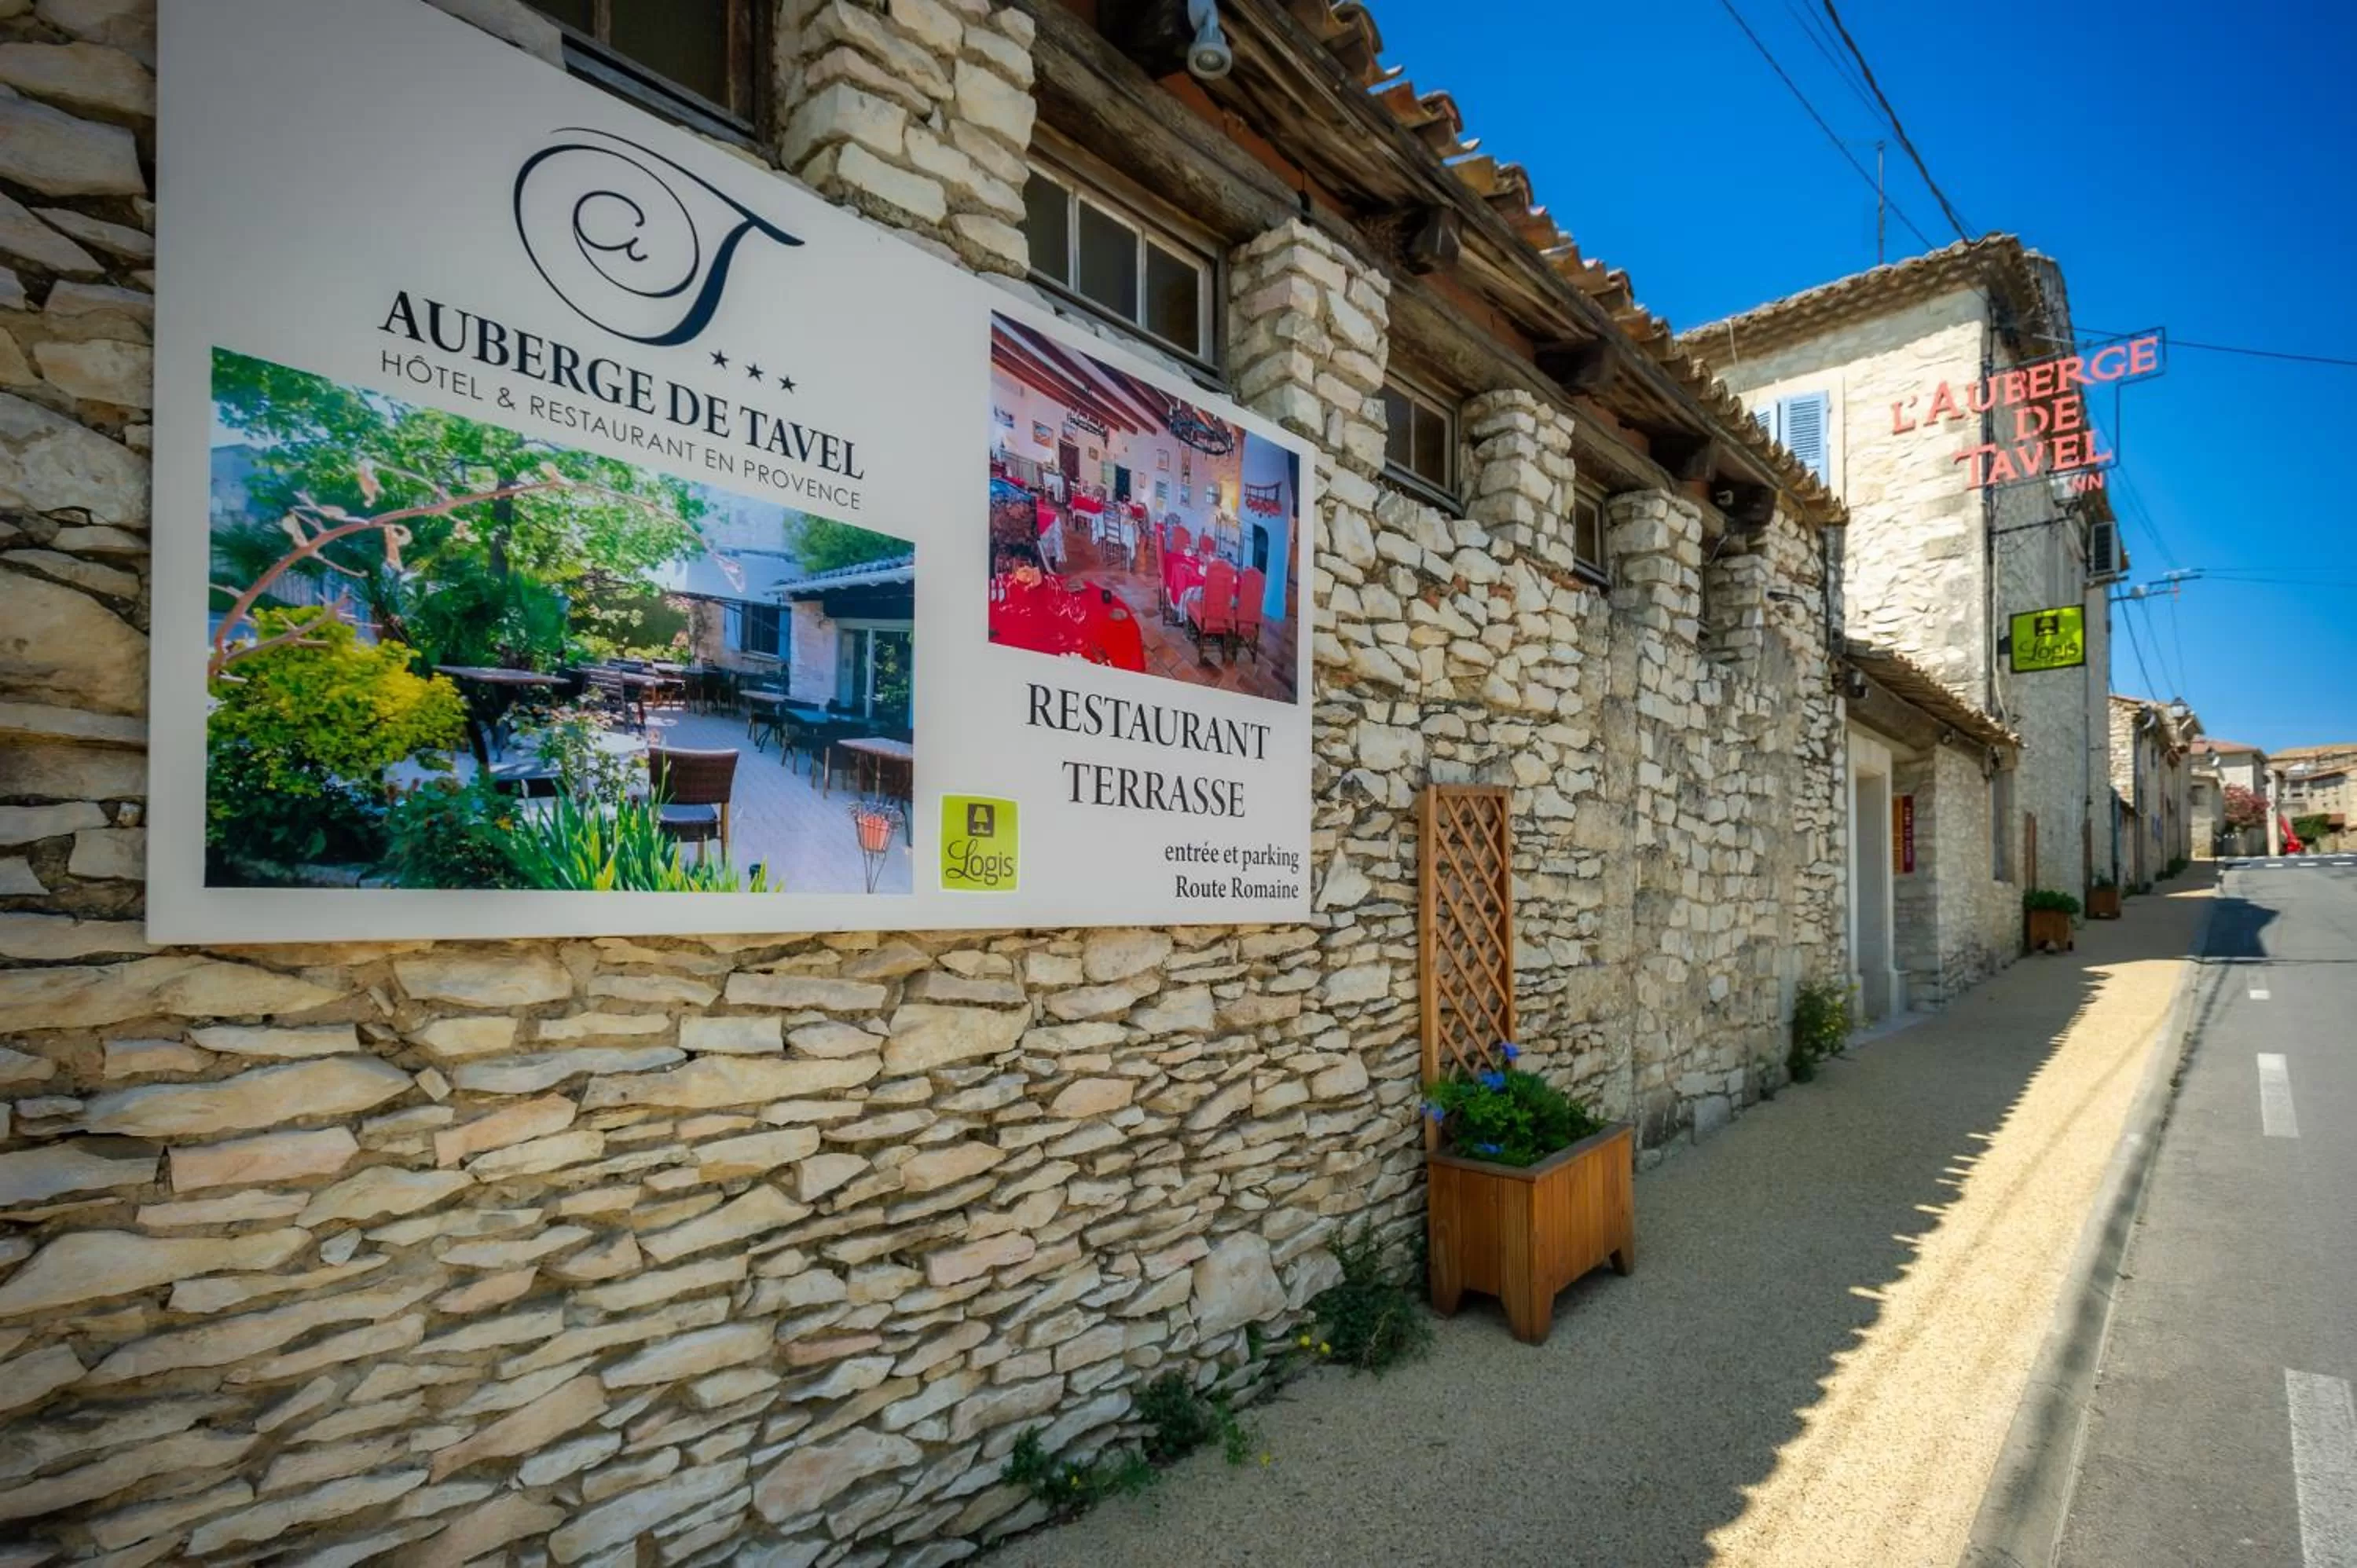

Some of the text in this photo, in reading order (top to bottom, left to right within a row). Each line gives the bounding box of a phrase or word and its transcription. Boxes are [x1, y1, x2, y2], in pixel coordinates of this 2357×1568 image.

[378, 291, 865, 480] AUBERGE DE TAVEL
[1892, 336, 2158, 435] L'AUBERGE
[381, 350, 861, 511] HÔTEL & RESTAURANT EN PROVENCE
[2013, 395, 2080, 441] DE
[1954, 430, 2113, 490] TAVEL
[2018, 636, 2079, 664] Logis
[1025, 683, 1270, 760] RESTAURANT
[1062, 761, 1245, 818] TERRASSE
[945, 838, 1014, 885] Logis
[1164, 841, 1299, 873] entrée et parking
[1175, 876, 1299, 899] Route Romaine
